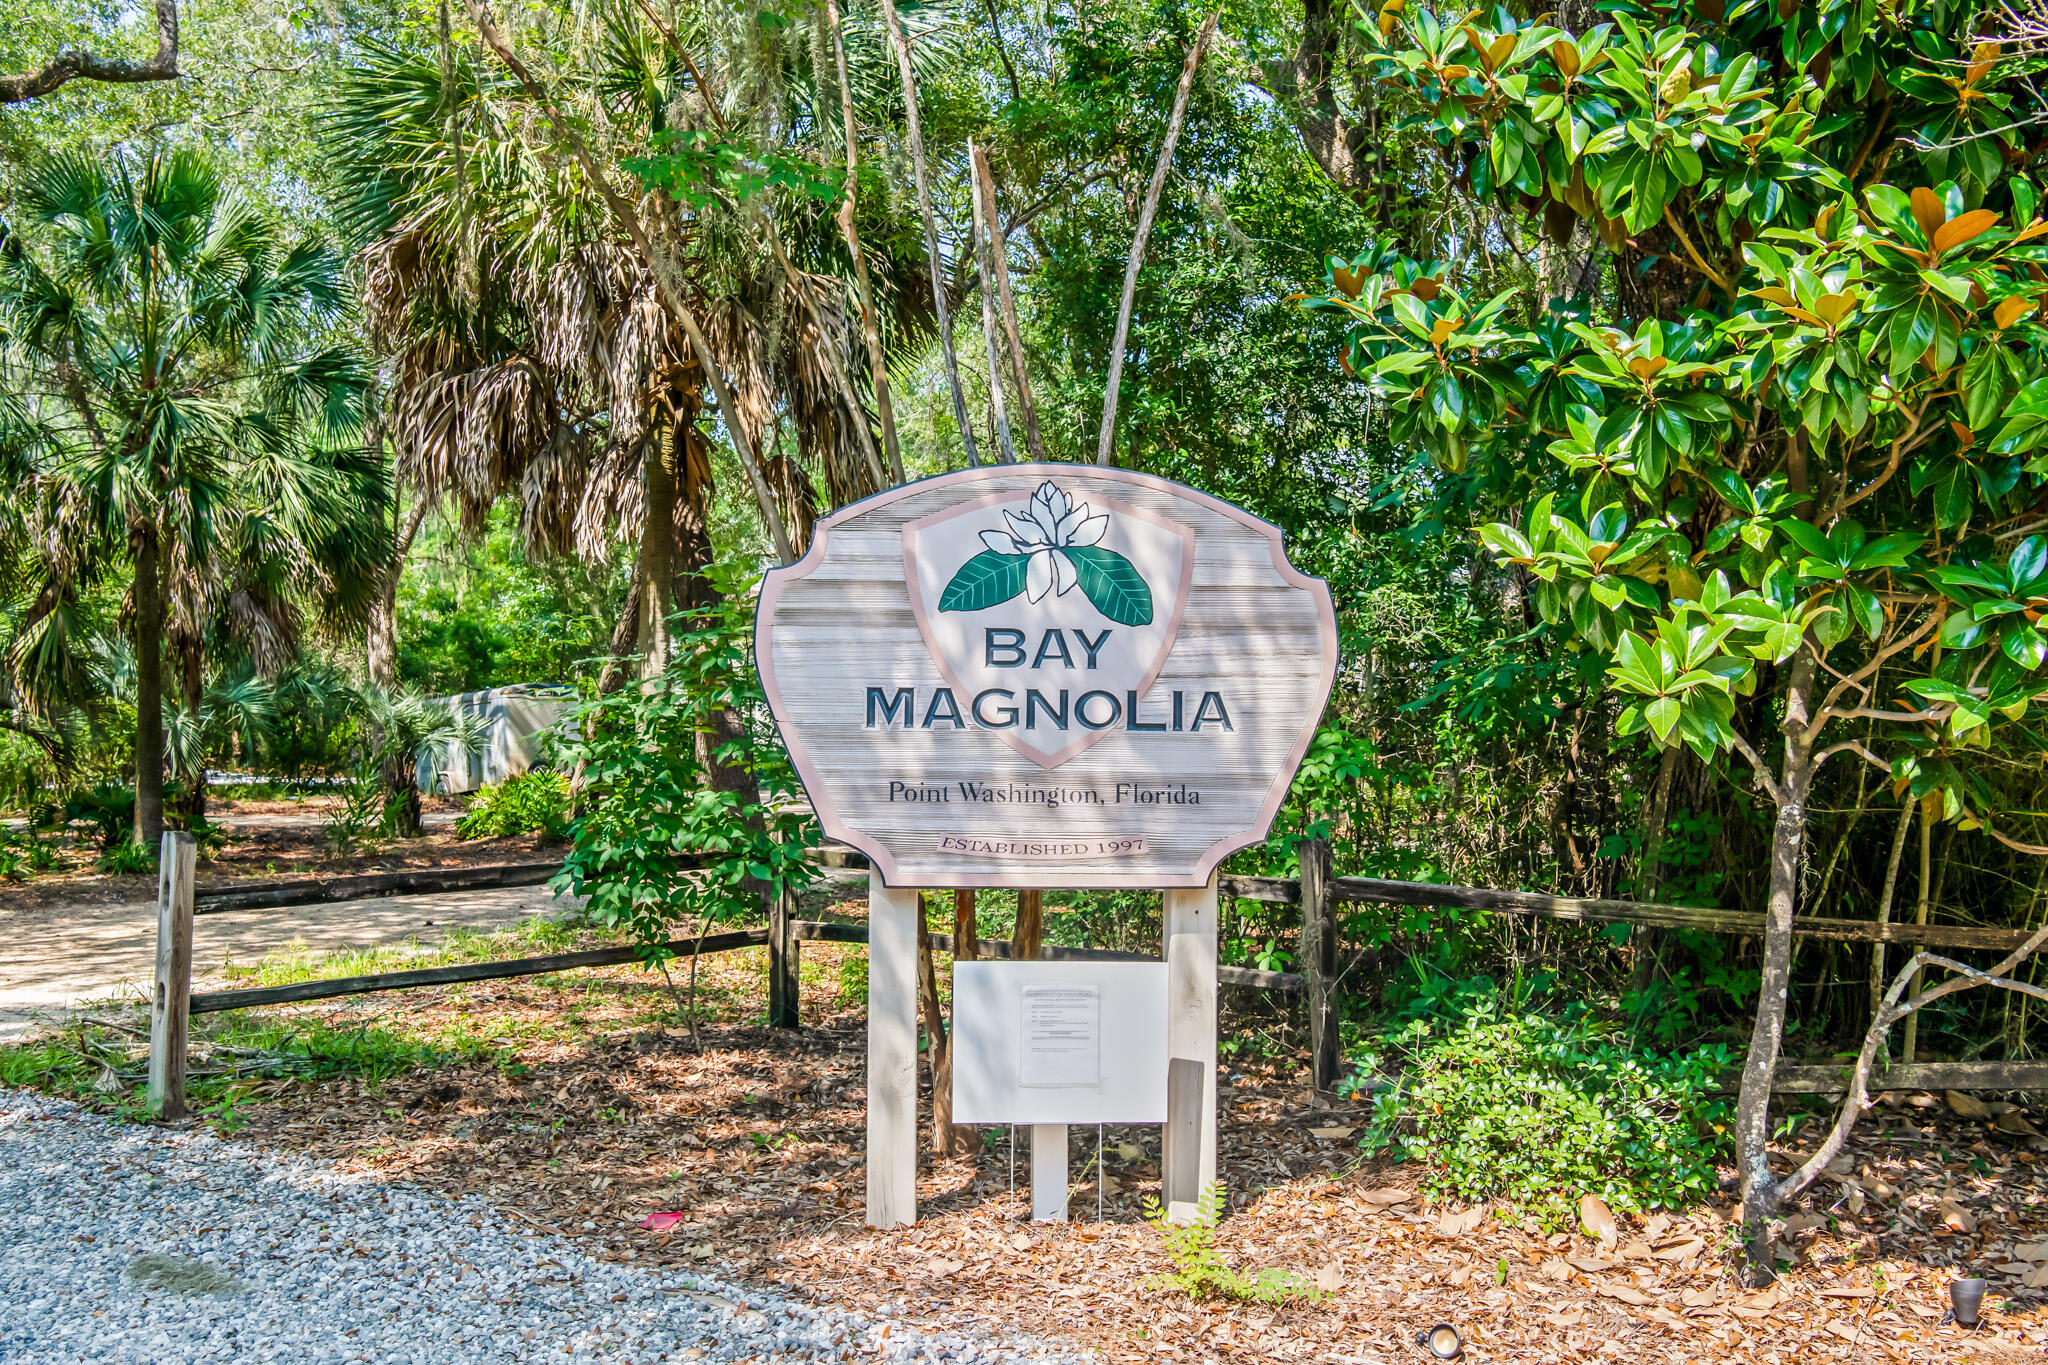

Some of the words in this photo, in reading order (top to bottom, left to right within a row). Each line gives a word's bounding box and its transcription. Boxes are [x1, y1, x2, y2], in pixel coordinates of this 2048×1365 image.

[985, 627, 1112, 669] BAY
[865, 687, 1233, 732] MAGNOLIA
[888, 781, 950, 803] Point
[959, 781, 1105, 808] Washington,
[1116, 783, 1200, 805] Florida
[941, 837, 1089, 856] ESTABLISHED
[1096, 839, 1144, 855] 1997
